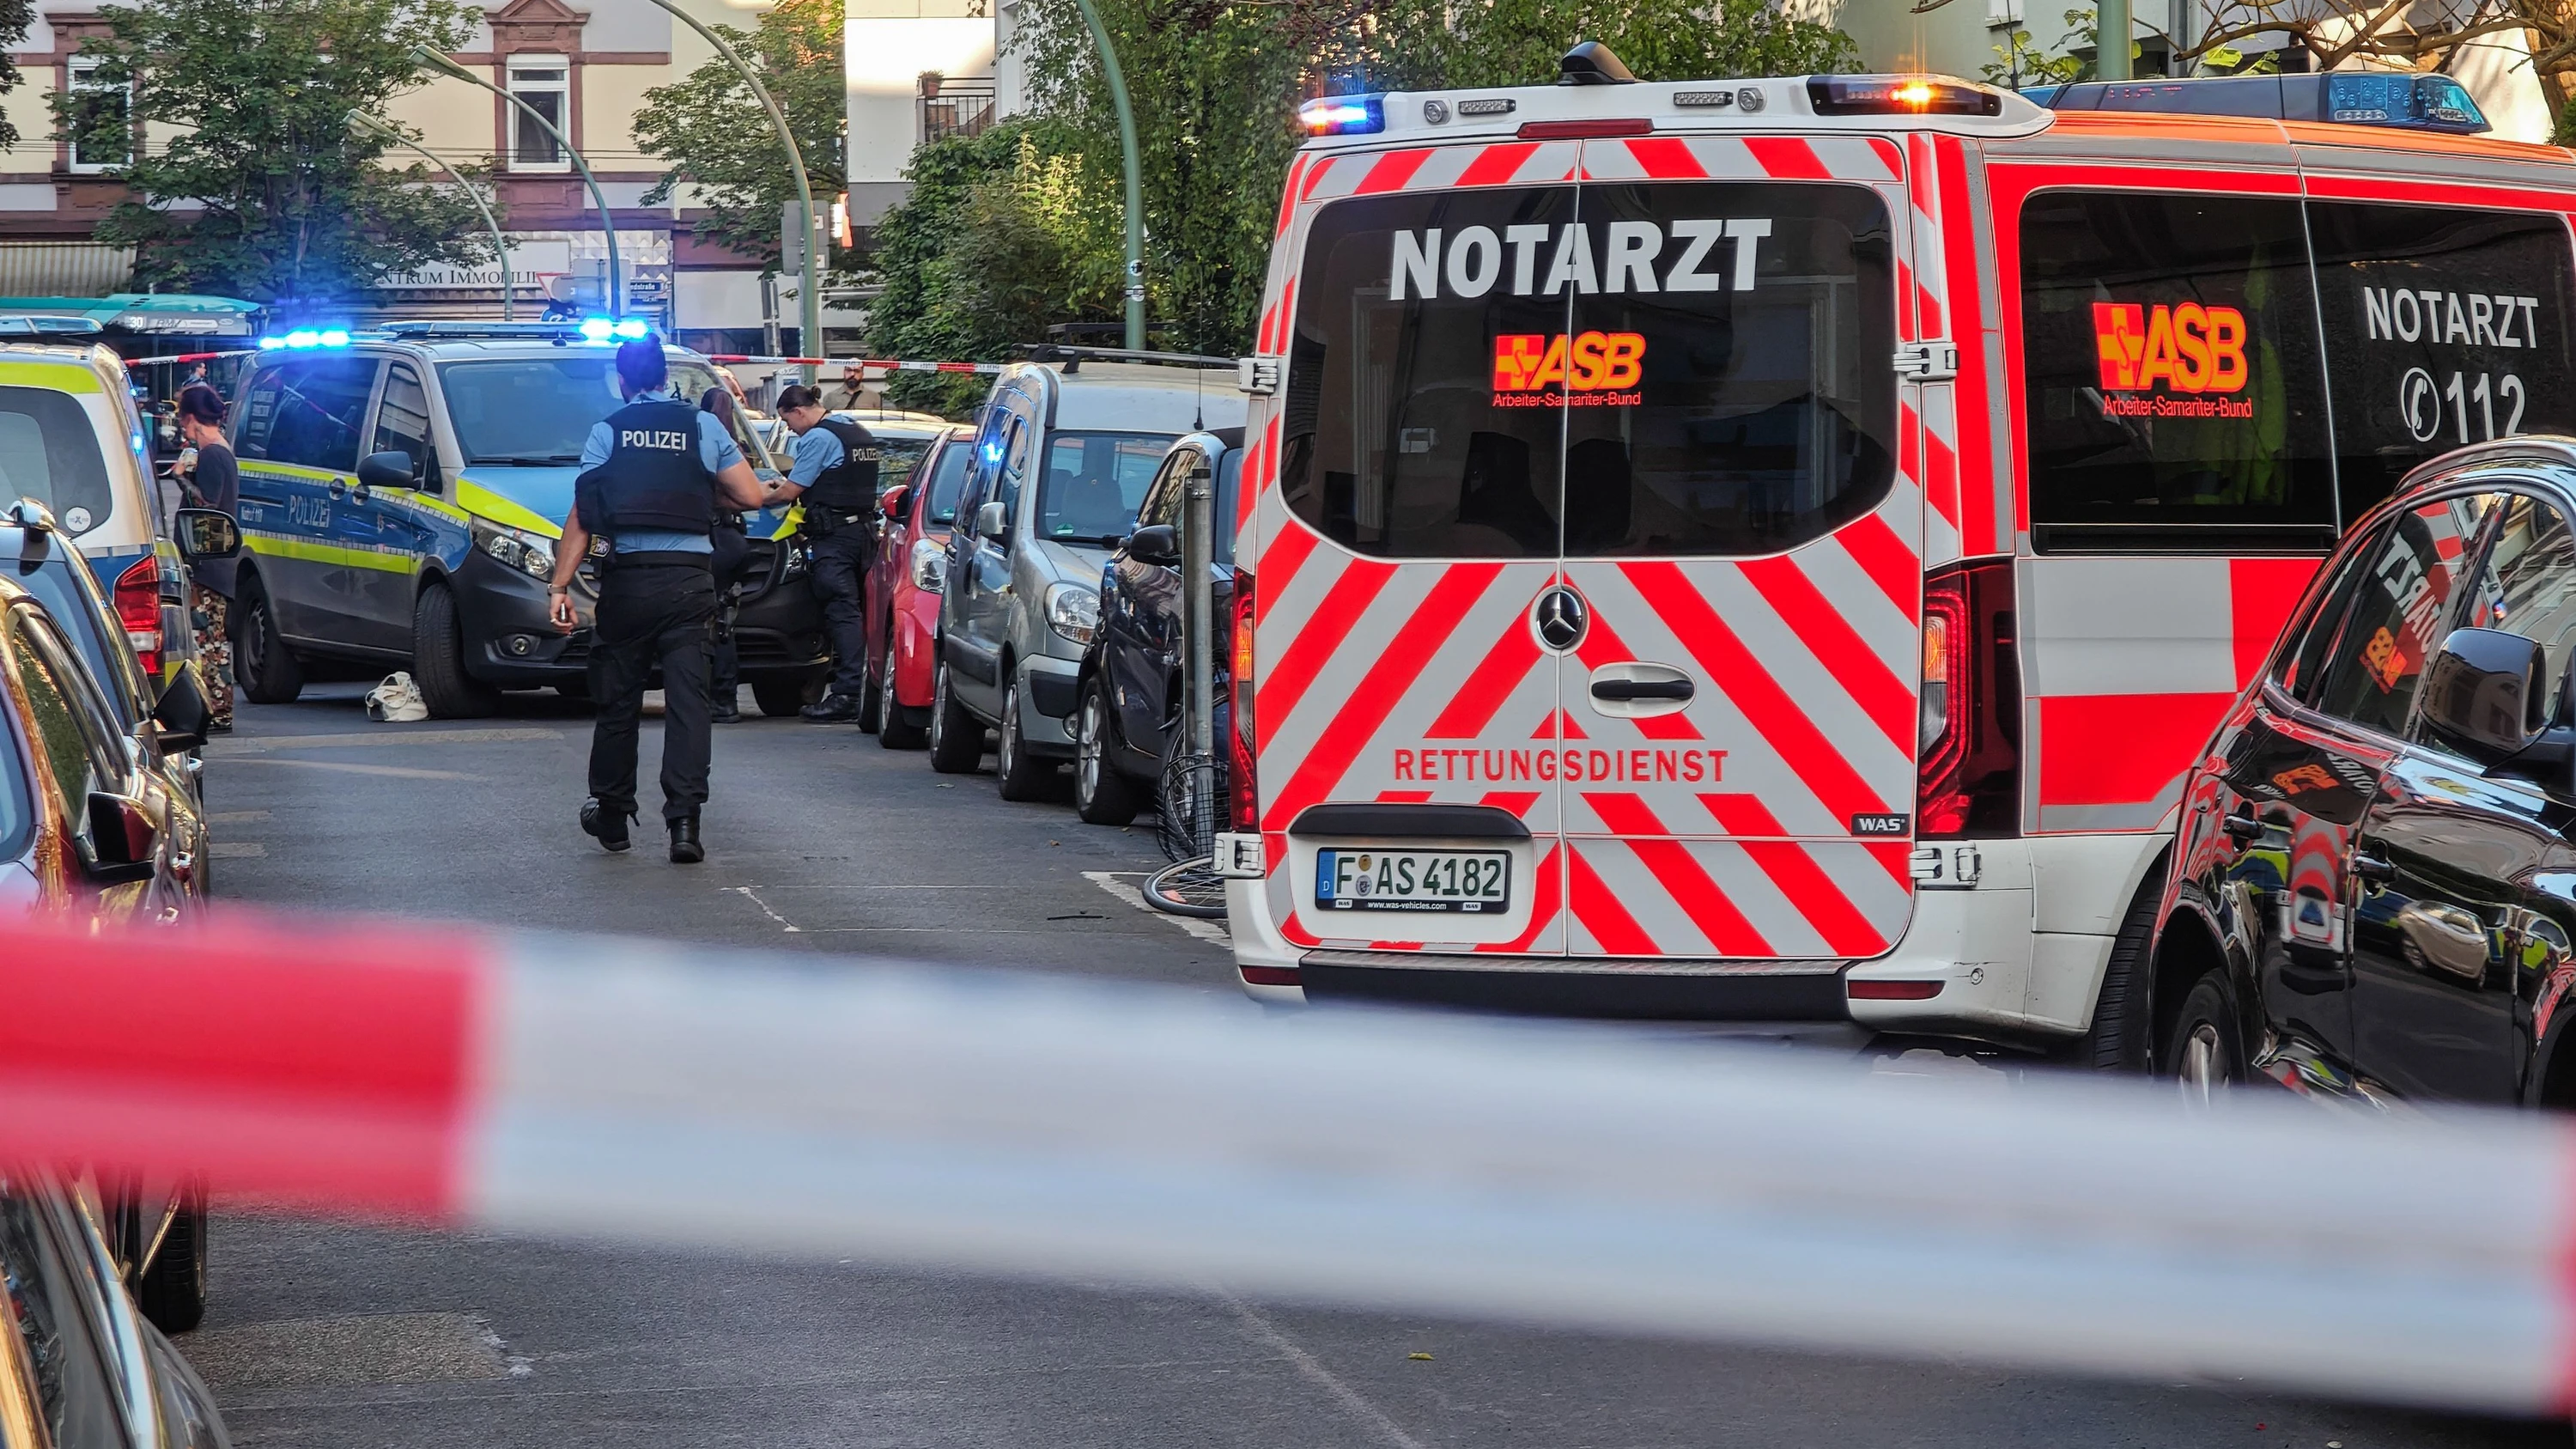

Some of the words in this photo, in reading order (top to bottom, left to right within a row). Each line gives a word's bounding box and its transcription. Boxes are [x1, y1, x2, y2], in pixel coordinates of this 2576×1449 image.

[1388, 218, 1772, 301] NOTARZT
[381, 271, 443, 284] NTRUM
[130, 317, 143, 328] 30
[2363, 285, 2539, 349] NOTARZT
[1526, 331, 1646, 391] ASB
[2135, 301, 2248, 394] ASB
[1492, 392, 1642, 407] Arbeiter-Samariter-Bund
[2103, 394, 2253, 418] Arbeiter-Samariter-Bund
[2446, 371, 2527, 444] 112
[622, 430, 686, 451] POLIZEI
[289, 494, 330, 528] POLIZEI
[1394, 749, 1728, 782] RETTUNGSDIENST
[1858, 818, 1901, 831] WAS
[1323, 880, 1330, 892] D
[1336, 857, 1356, 894] F
[1376, 857, 1416, 895] AS
[1423, 858, 1502, 897] 4182
[1368, 901, 1447, 910] www.was-vehicles.com
